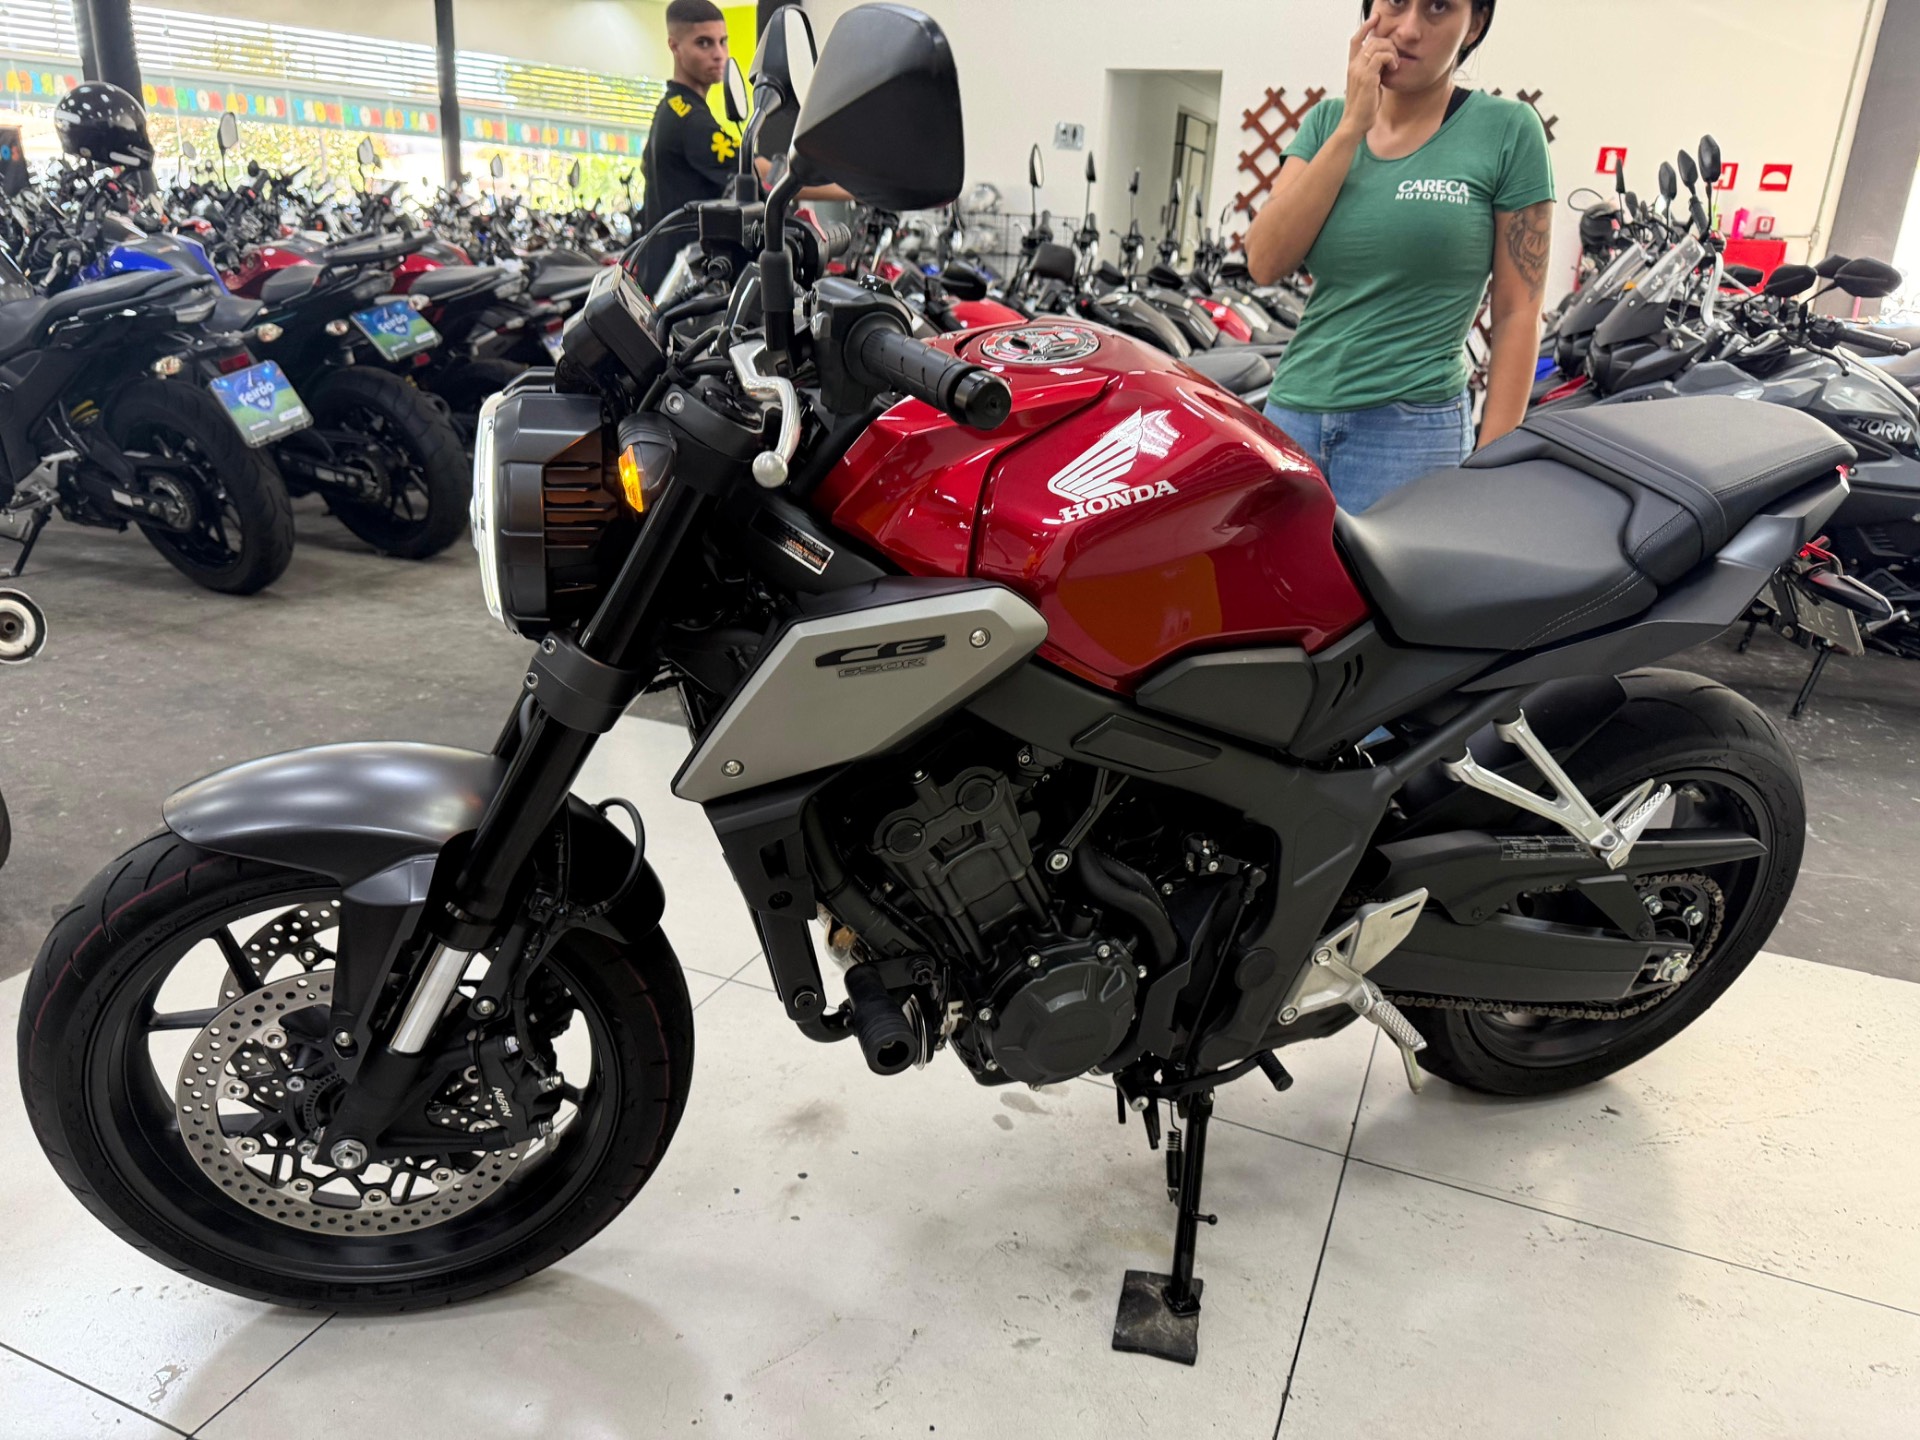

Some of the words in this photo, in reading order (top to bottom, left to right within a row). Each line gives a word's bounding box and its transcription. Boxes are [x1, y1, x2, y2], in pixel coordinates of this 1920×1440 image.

[1395, 192, 1469, 205] MOTOSPORT
[1398, 180, 1469, 197] CARECA
[1847, 418, 1912, 443] STORM
[1058, 479, 1179, 523] HONDA
[815, 634, 946, 667] CB
